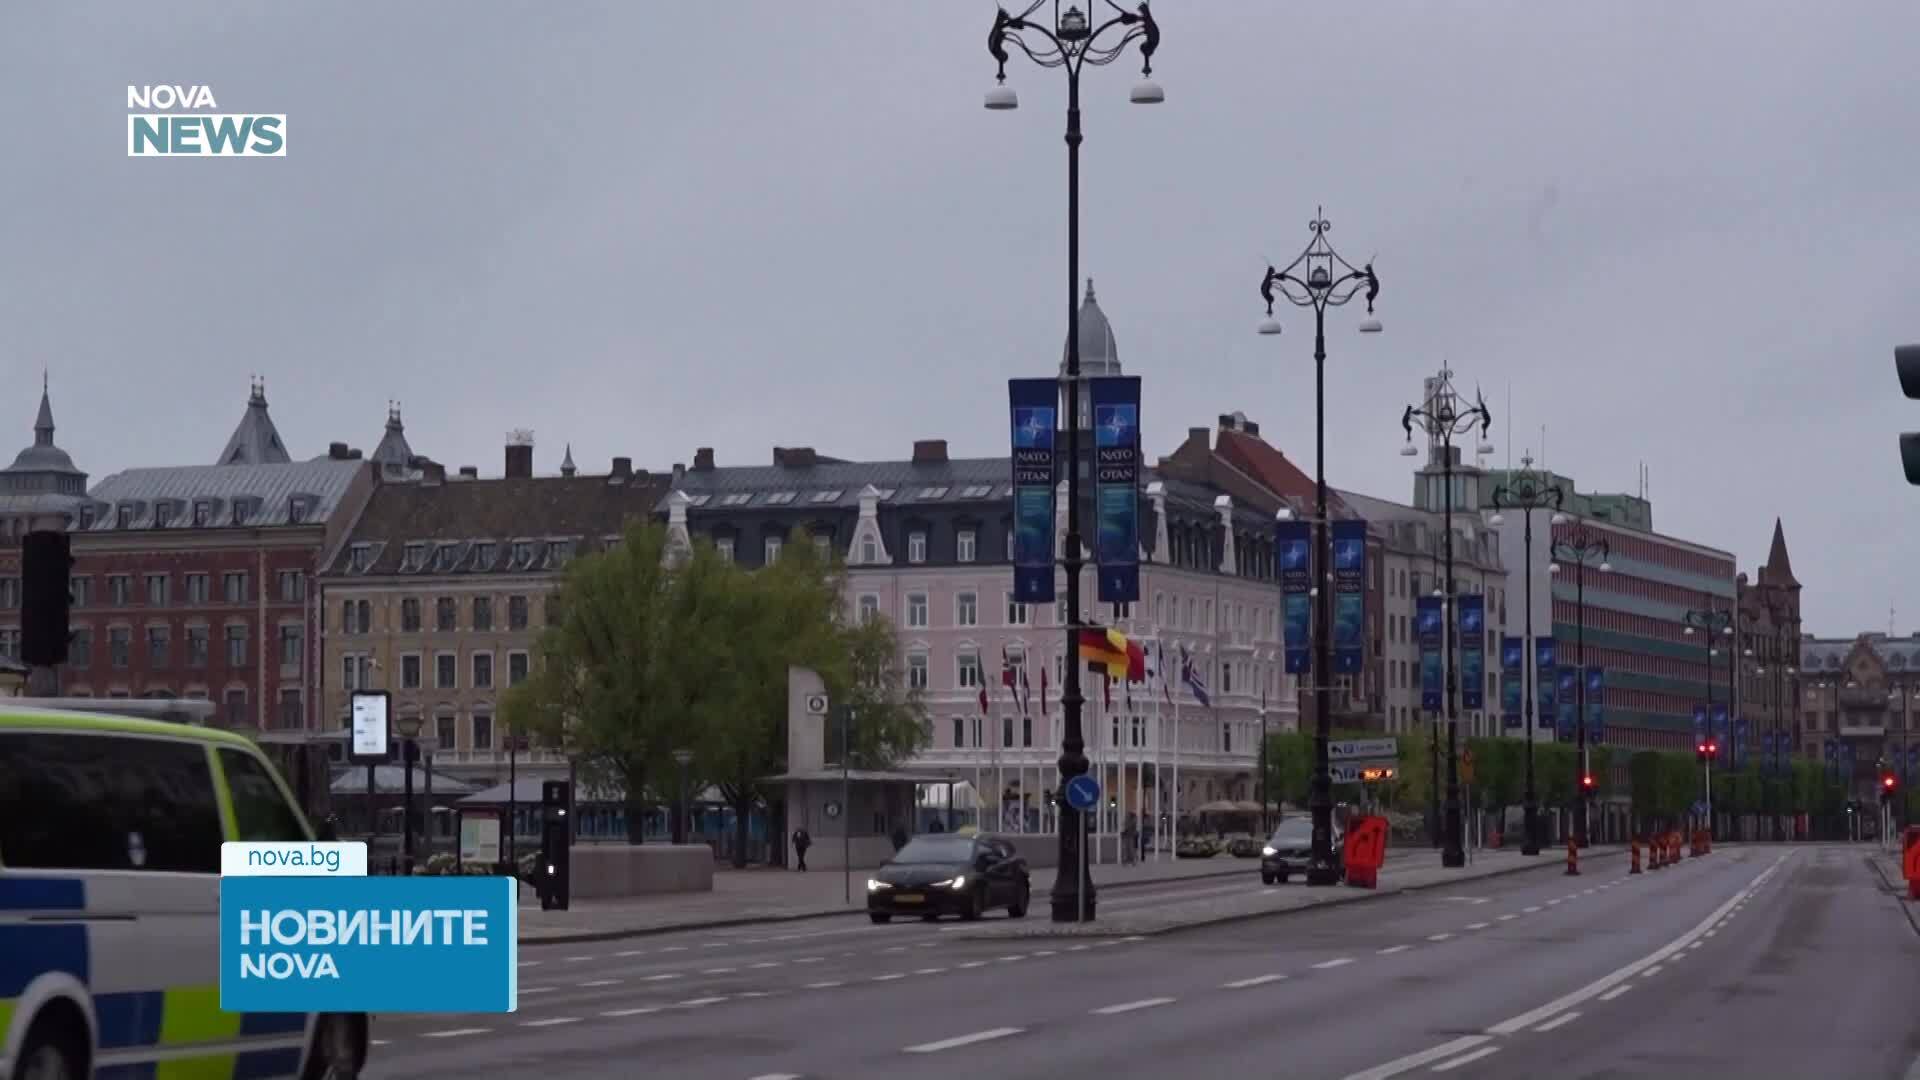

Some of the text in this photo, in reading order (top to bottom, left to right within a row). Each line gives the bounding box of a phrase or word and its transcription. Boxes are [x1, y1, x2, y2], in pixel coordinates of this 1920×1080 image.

[1018, 451, 1050, 461] NATO
[1101, 449, 1133, 460] NATO
[1017, 471, 1050, 481] OTAN
[1100, 469, 1133, 480] OTAN
